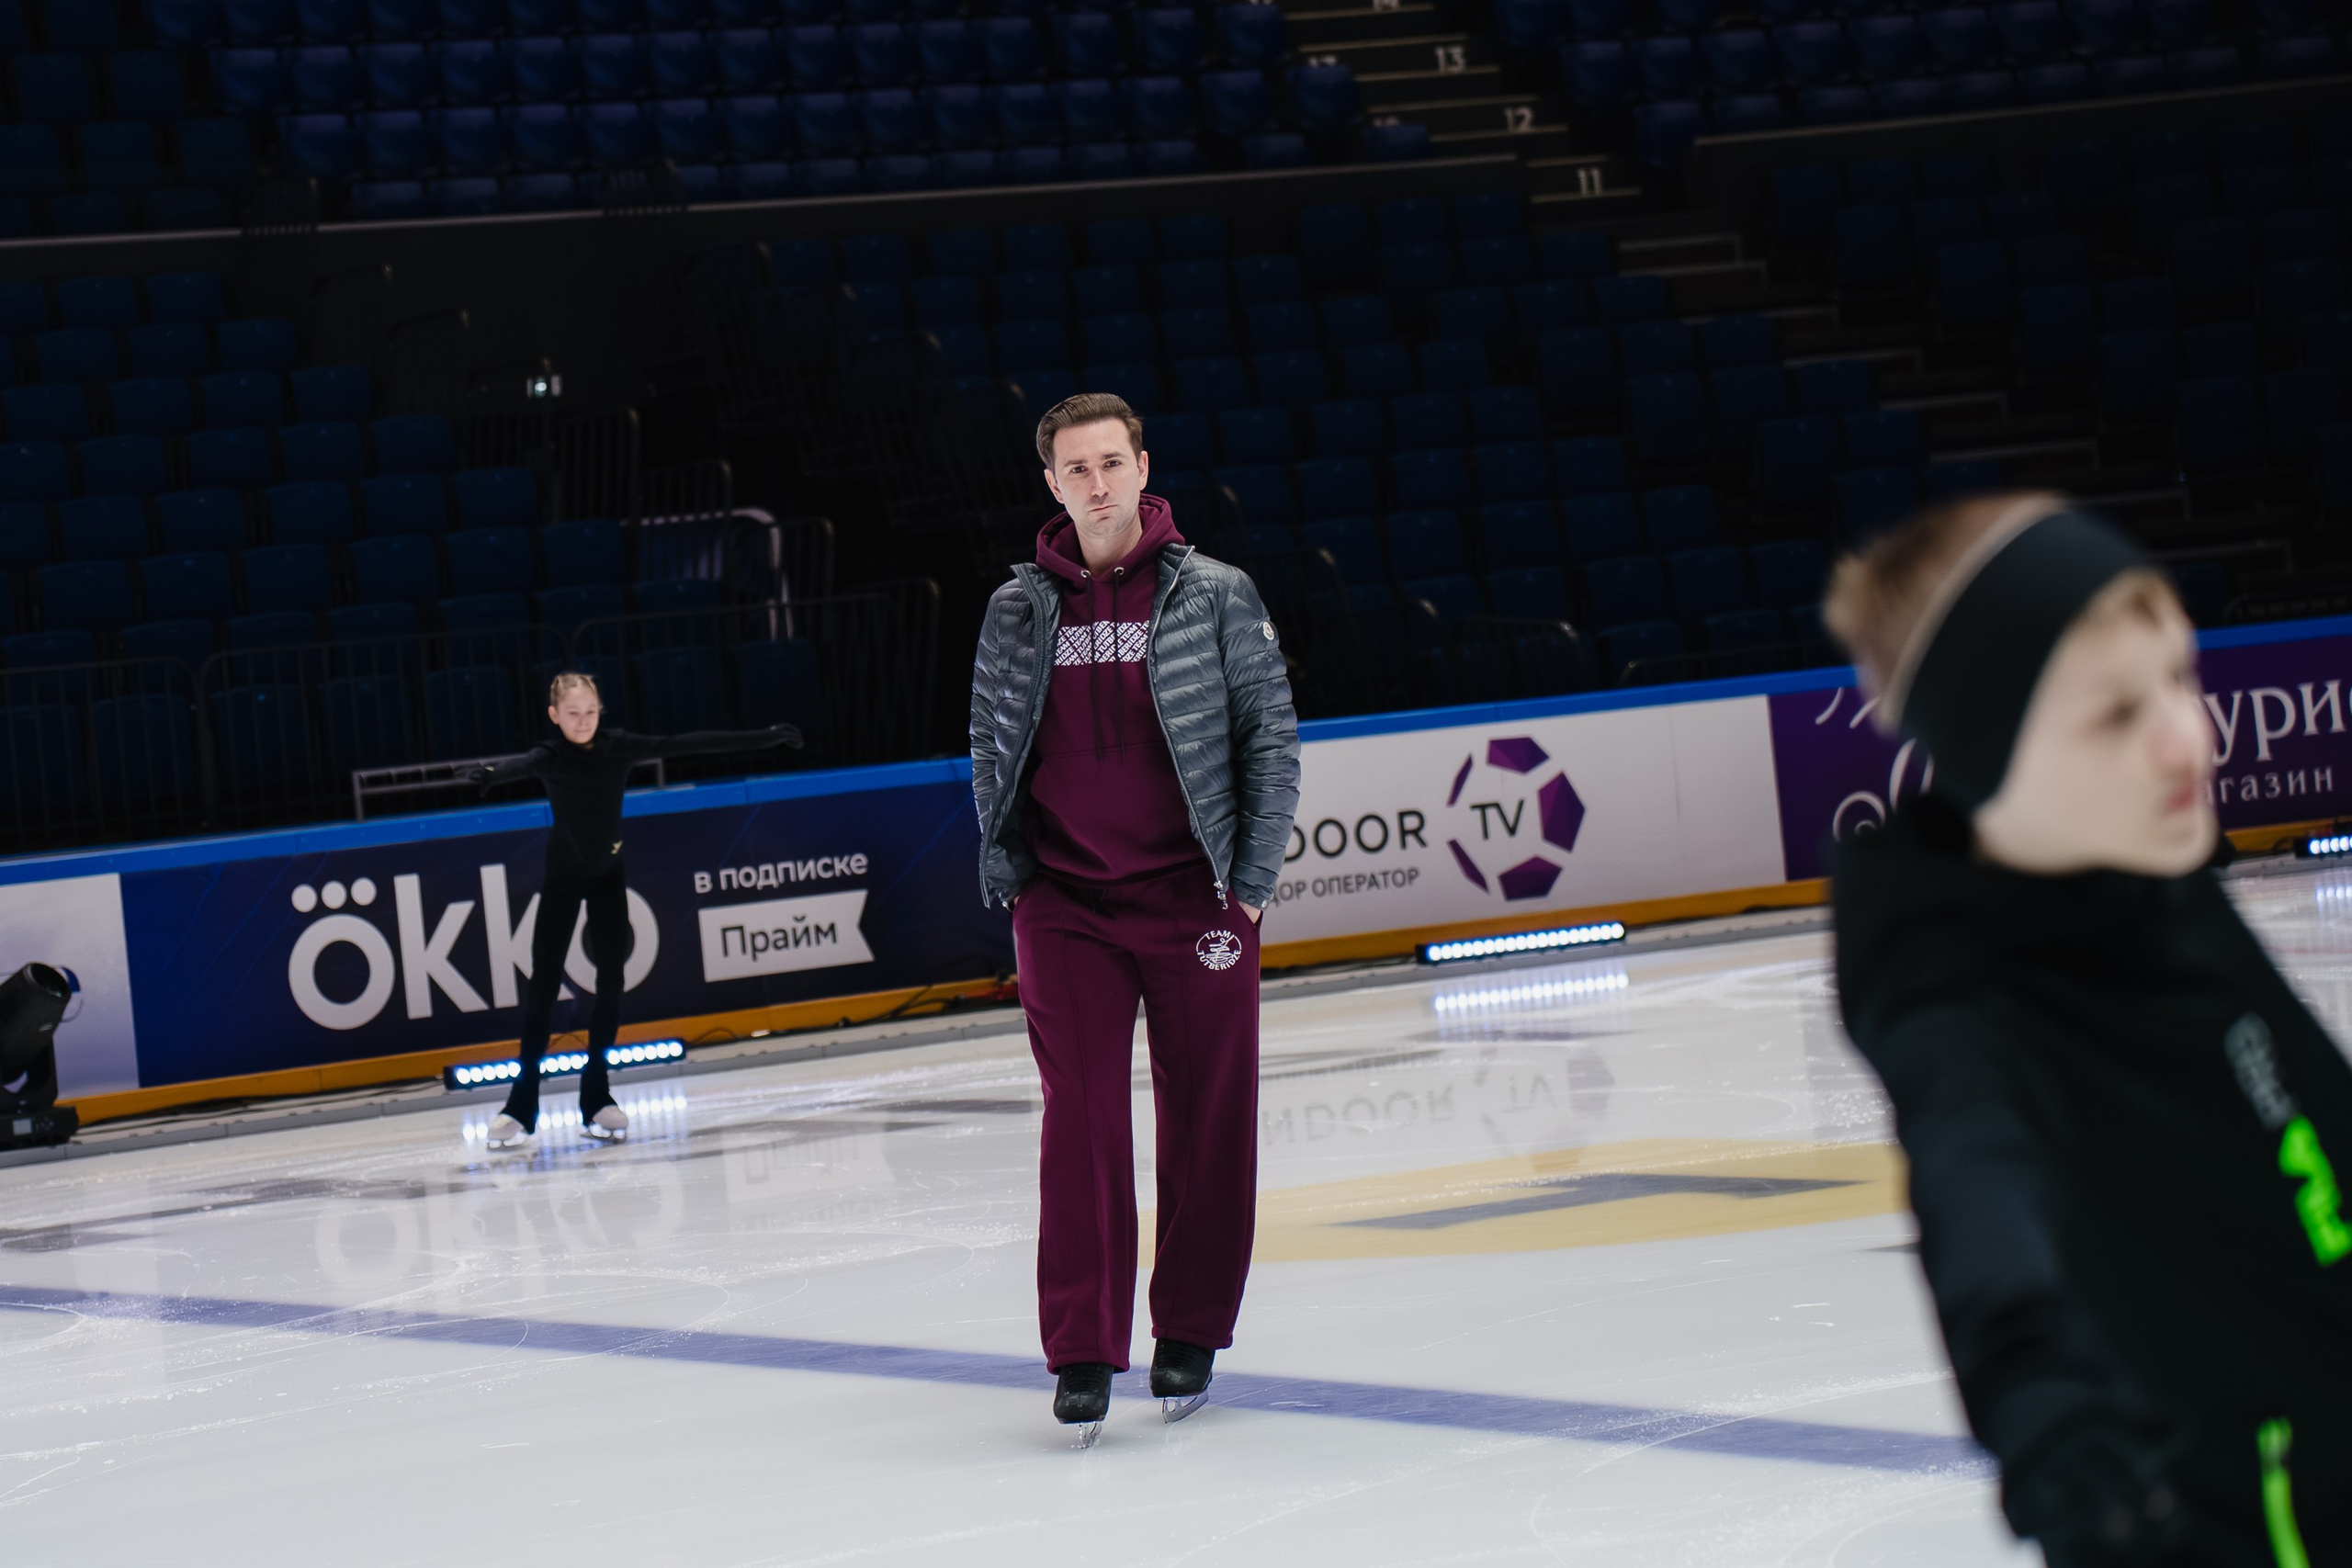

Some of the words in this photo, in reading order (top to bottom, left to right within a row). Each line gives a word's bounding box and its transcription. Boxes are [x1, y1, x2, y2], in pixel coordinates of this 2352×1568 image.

[1435, 45, 1466, 73] 13
[1505, 107, 1533, 132] 12
[1577, 168, 1602, 196] 11
[2203, 679, 2352, 767] ури
[1470, 798, 1525, 840] TV
[694, 871, 714, 894] в
[719, 852, 869, 891] подписке
[1311, 868, 1419, 898] ОПЕРАТОР
[720, 915, 838, 962] Прайм
[1204, 930, 1231, 941] TEAM
[1196, 949, 1242, 971] TUTBERIDZE
